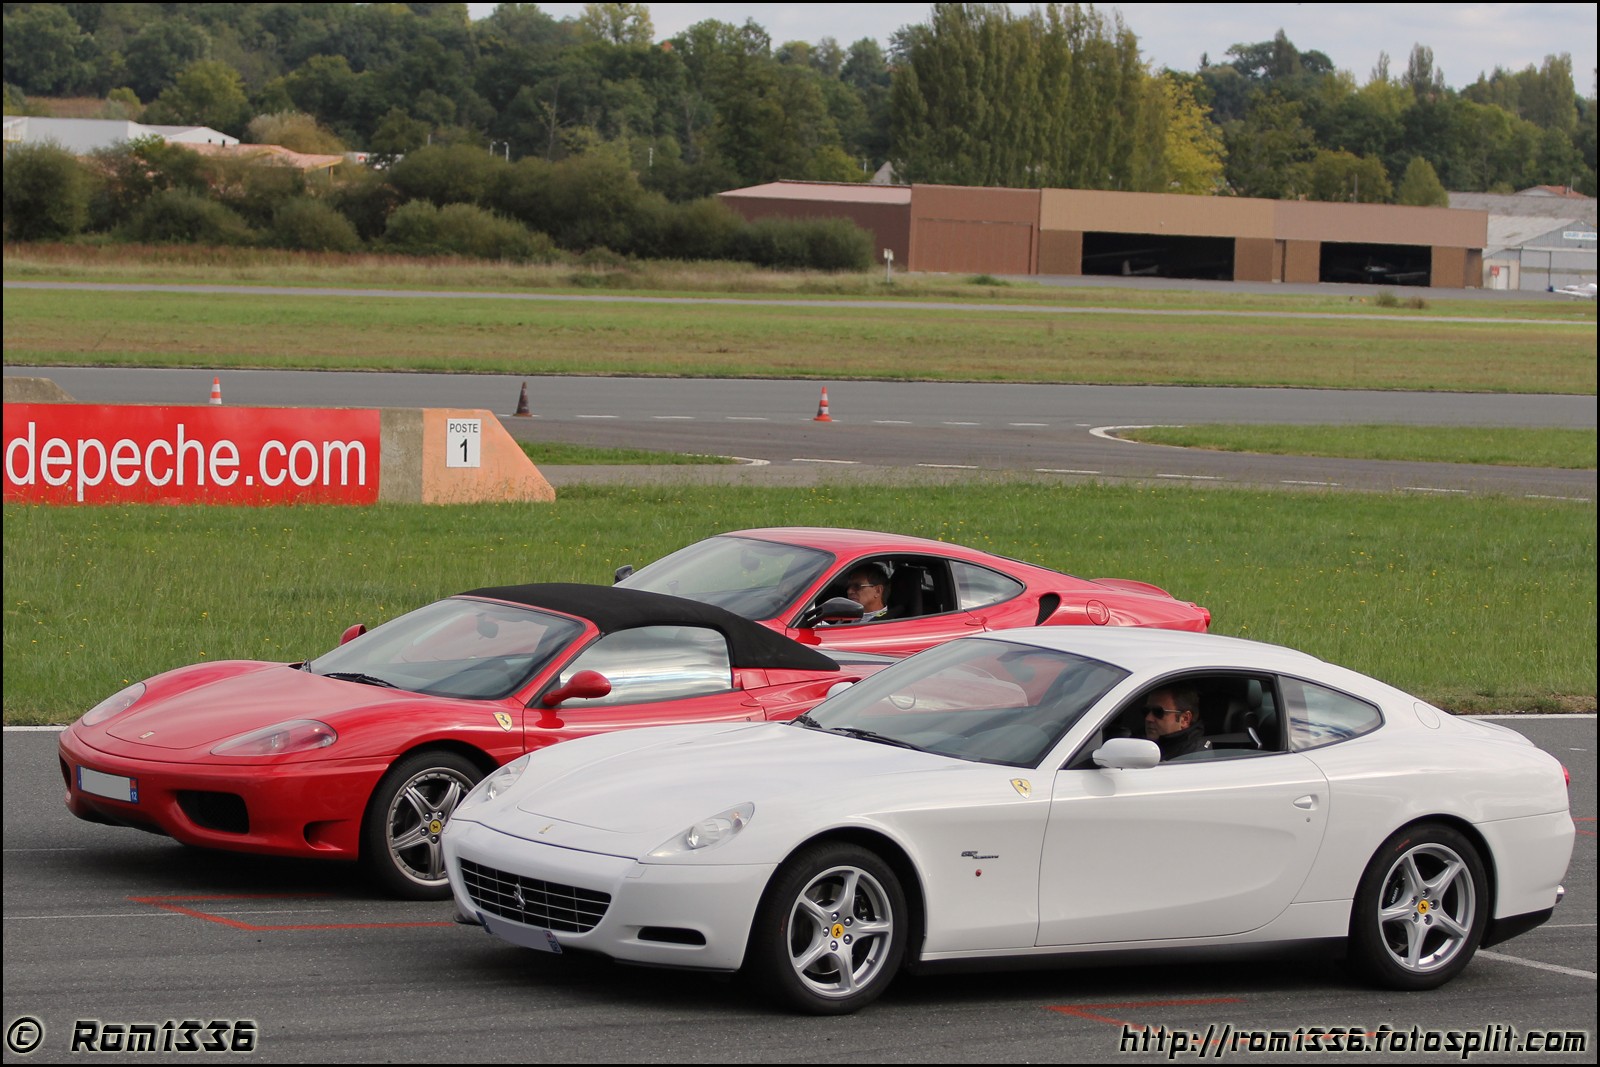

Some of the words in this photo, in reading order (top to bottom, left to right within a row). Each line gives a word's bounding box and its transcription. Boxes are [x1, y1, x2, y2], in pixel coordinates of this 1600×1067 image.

[449, 423, 478, 433] POSTE
[5, 421, 366, 502] depeche.com
[460, 438, 467, 462] 1
